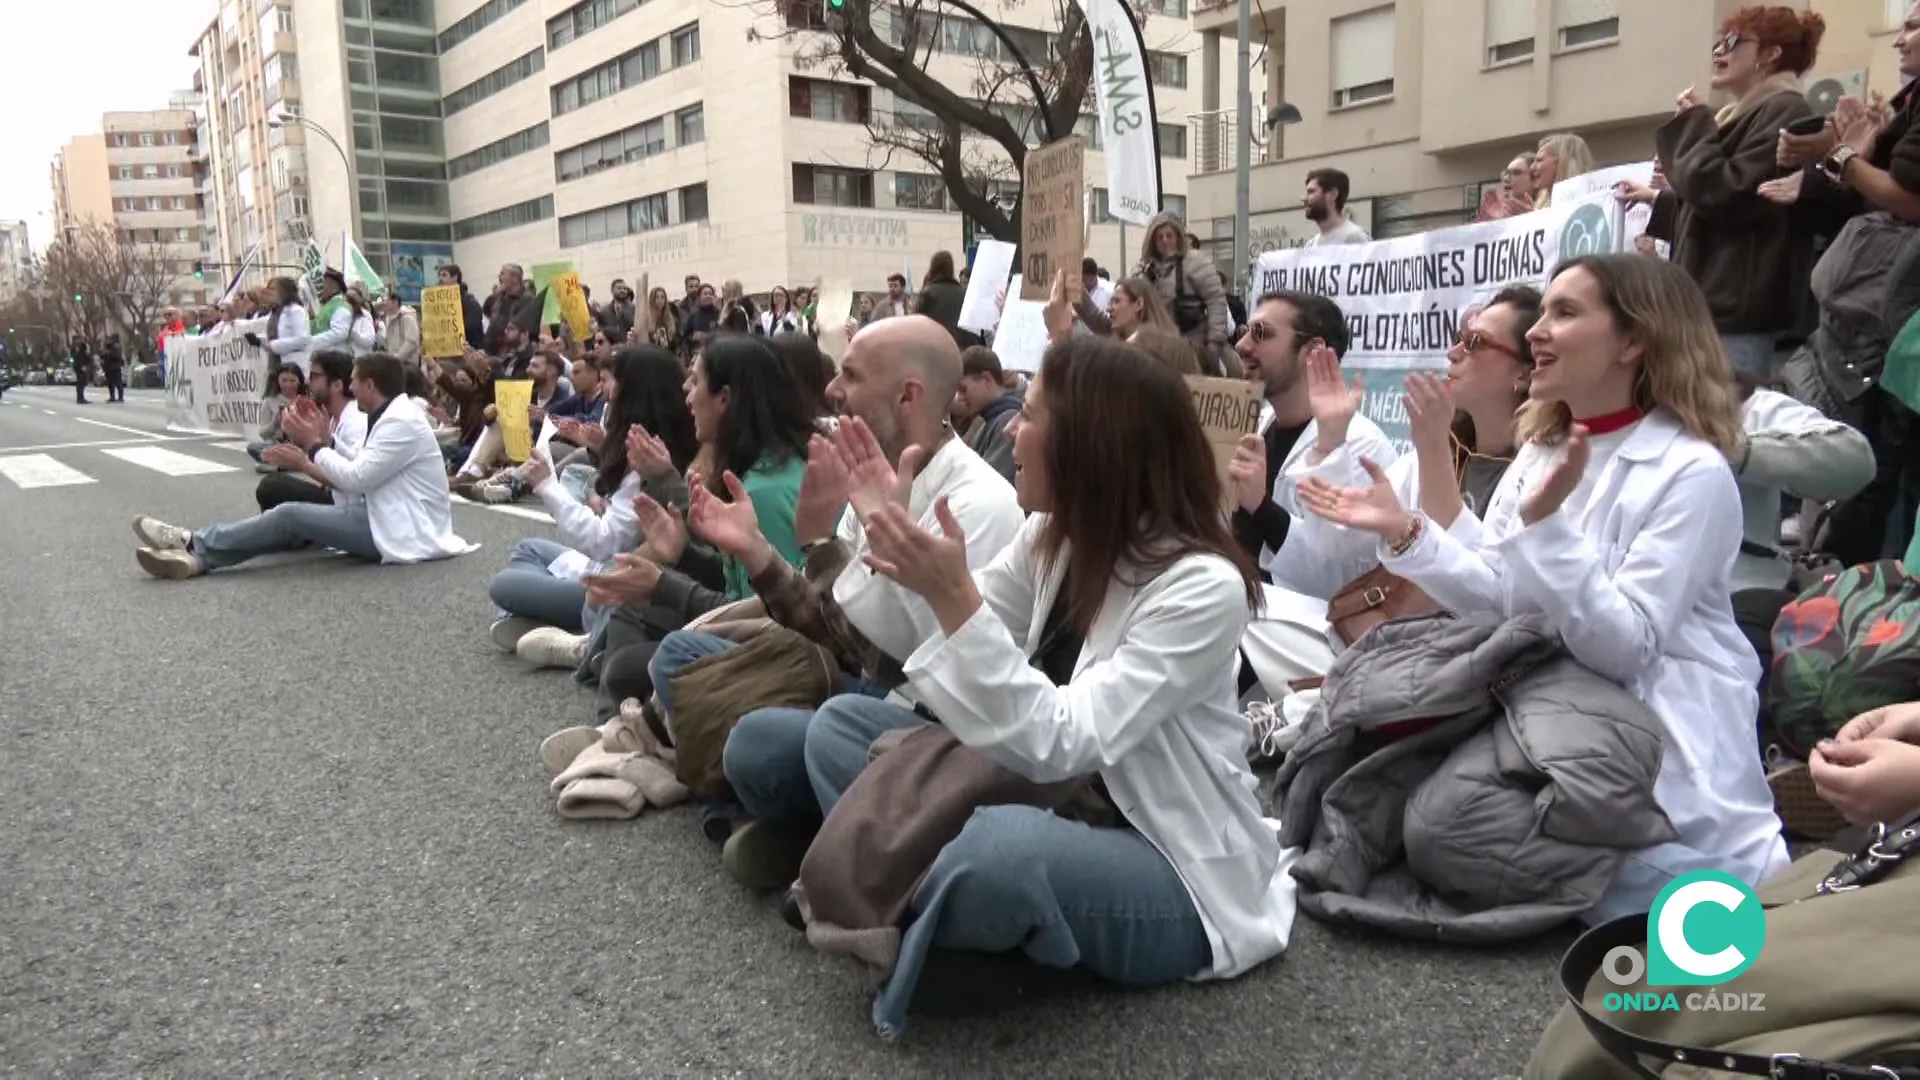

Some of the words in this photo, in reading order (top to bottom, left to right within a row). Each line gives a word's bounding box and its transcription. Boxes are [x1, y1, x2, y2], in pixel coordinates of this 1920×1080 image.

[819, 214, 907, 237] PREVENTIVA
[1263, 267, 1288, 296] POR
[1293, 264, 1341, 297] UNAS
[1346, 250, 1465, 296] CONDICIONES
[1473, 229, 1545, 285] DIGNAS
[1344, 301, 1458, 351] PLOTACIÓN
